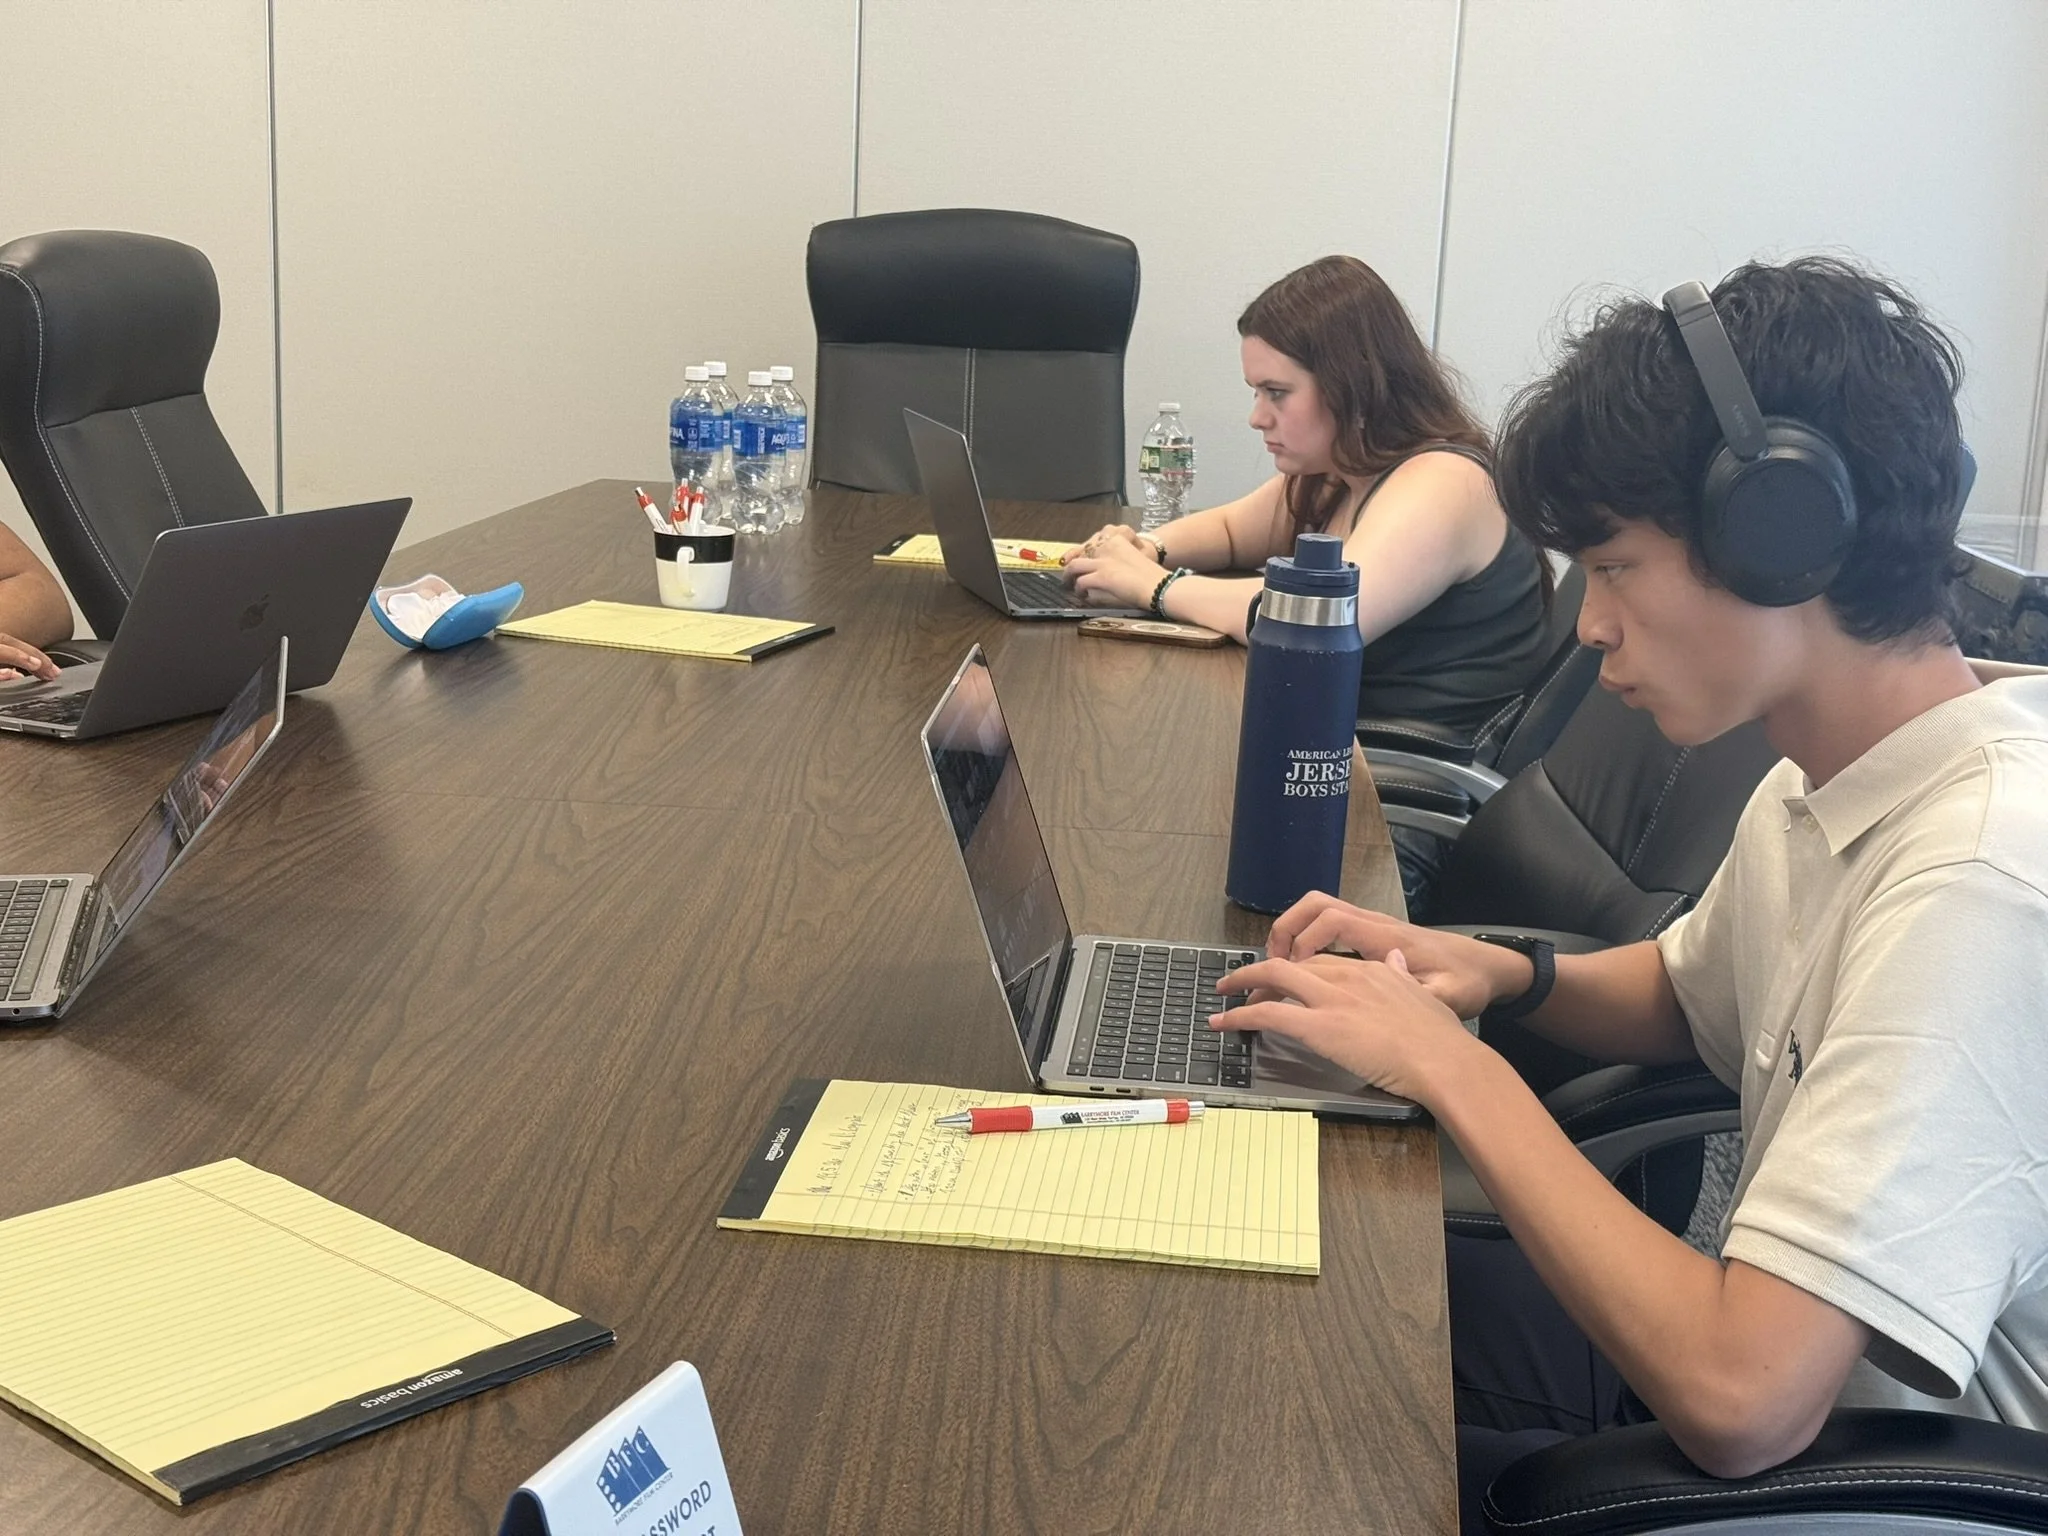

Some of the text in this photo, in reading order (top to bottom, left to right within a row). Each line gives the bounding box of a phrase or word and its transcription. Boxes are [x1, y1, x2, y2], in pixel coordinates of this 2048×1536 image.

[1287, 749, 1341, 759] AMERICAN
[1283, 782, 1329, 797] BOYS
[360, 1368, 464, 1409] amazon basics
[605, 1430, 650, 1480] BFC
[641, 1480, 712, 1536] SWORD
